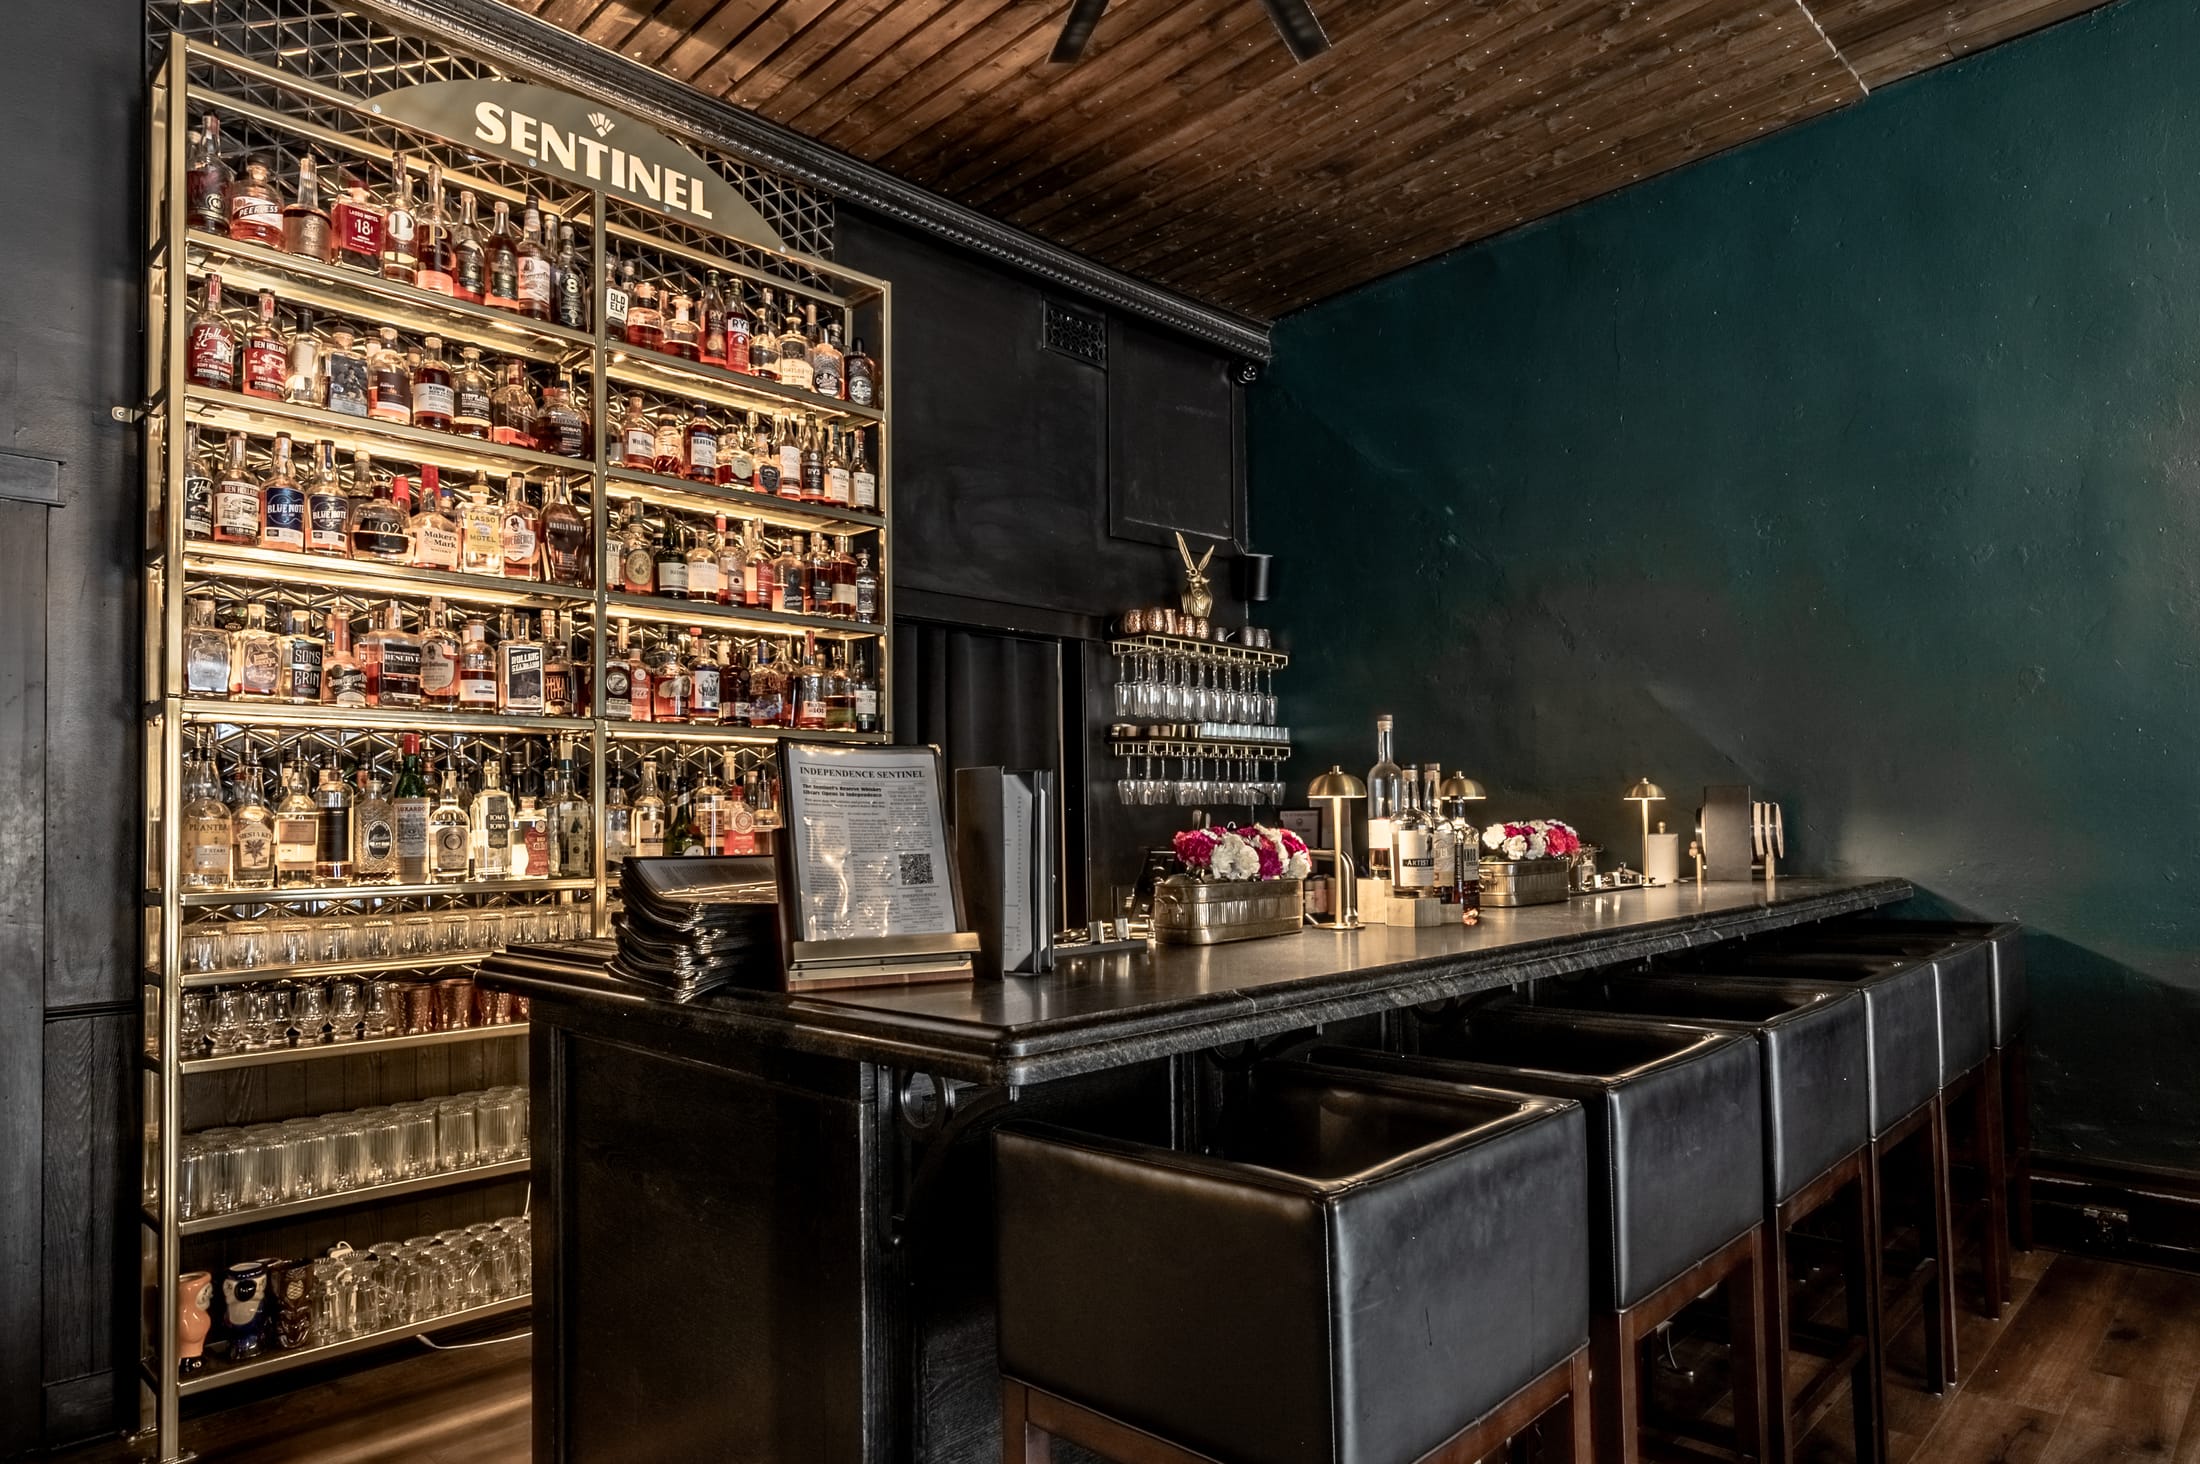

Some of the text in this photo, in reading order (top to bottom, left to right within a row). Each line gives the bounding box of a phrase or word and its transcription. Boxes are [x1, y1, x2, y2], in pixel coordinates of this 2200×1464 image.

[474, 101, 713, 220] SENTINEL
[239, 205, 279, 217] PEERLESS
[357, 219, 371, 236] 18
[610, 292, 626, 305] OLD
[610, 301, 625, 315] ELK
[267, 503, 304, 515] BLUE NOTE
[313, 510, 347, 520] BLUE NOTE
[470, 514, 496, 523] LASSO
[368, 520, 400, 538] 1792
[433, 538, 457, 549] Mark
[470, 534, 496, 543] MOTEL
[295, 649, 321, 665] SONS
[294, 670, 320, 688] ERIN
[800, 766, 926, 779] INDEPENDENCE SENTINEL
[1406, 859, 1430, 867] ARTIST
